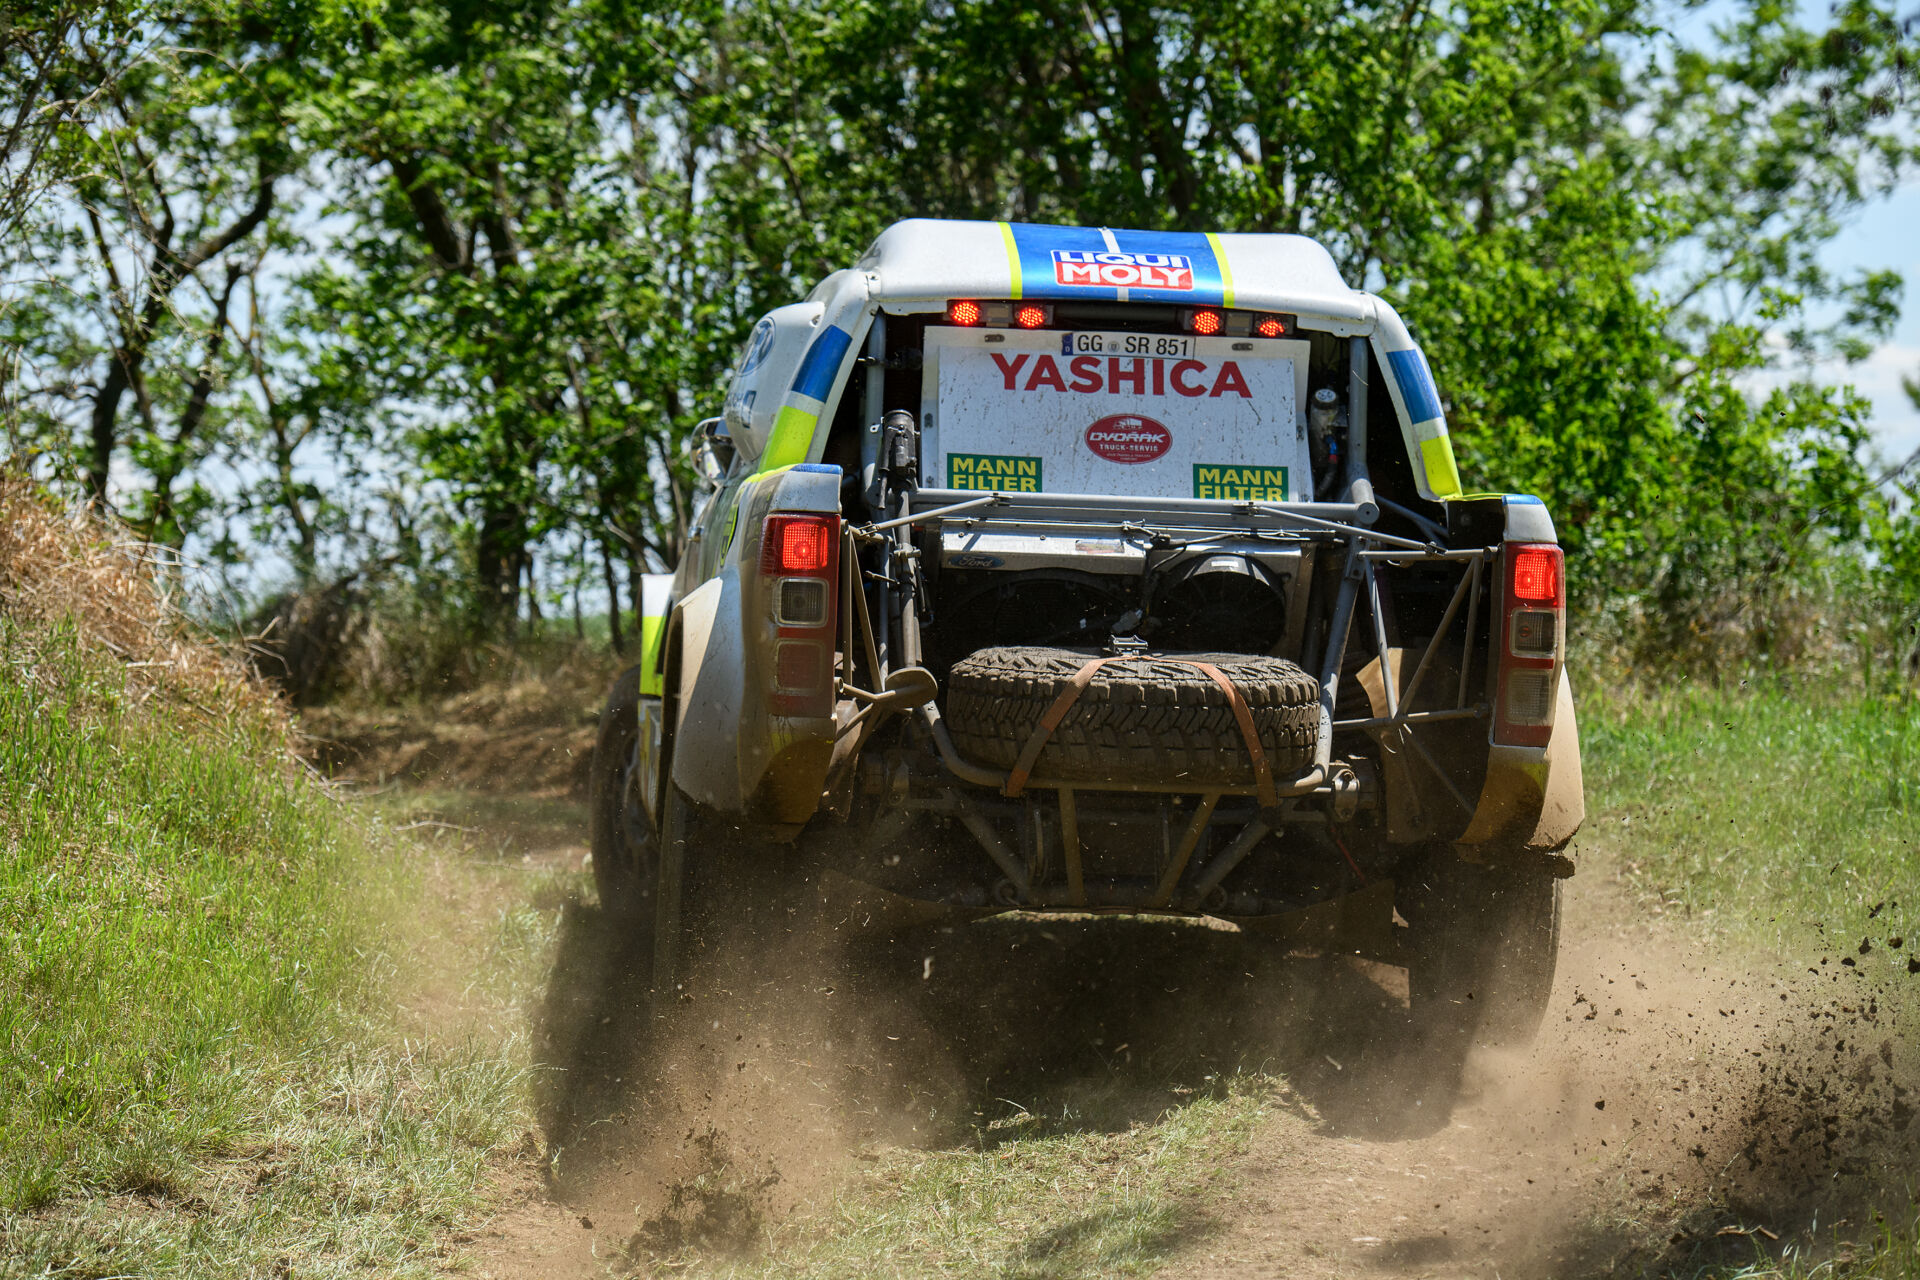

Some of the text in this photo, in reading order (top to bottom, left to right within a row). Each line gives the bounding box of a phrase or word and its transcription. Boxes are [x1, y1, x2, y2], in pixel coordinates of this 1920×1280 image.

[1059, 252, 1184, 267] LIQUI
[1061, 263, 1189, 287] MOLY
[1077, 334, 1103, 352] GG
[1124, 336, 1150, 354] SR
[1155, 338, 1188, 356] 851
[990, 353, 1253, 398] YASHICA
[953, 457, 1037, 476] MANN
[953, 474, 1037, 492] FILTER
[1199, 468, 1283, 486] MANN
[1199, 485, 1283, 502] FILTER
[958, 555, 993, 567] Ford
